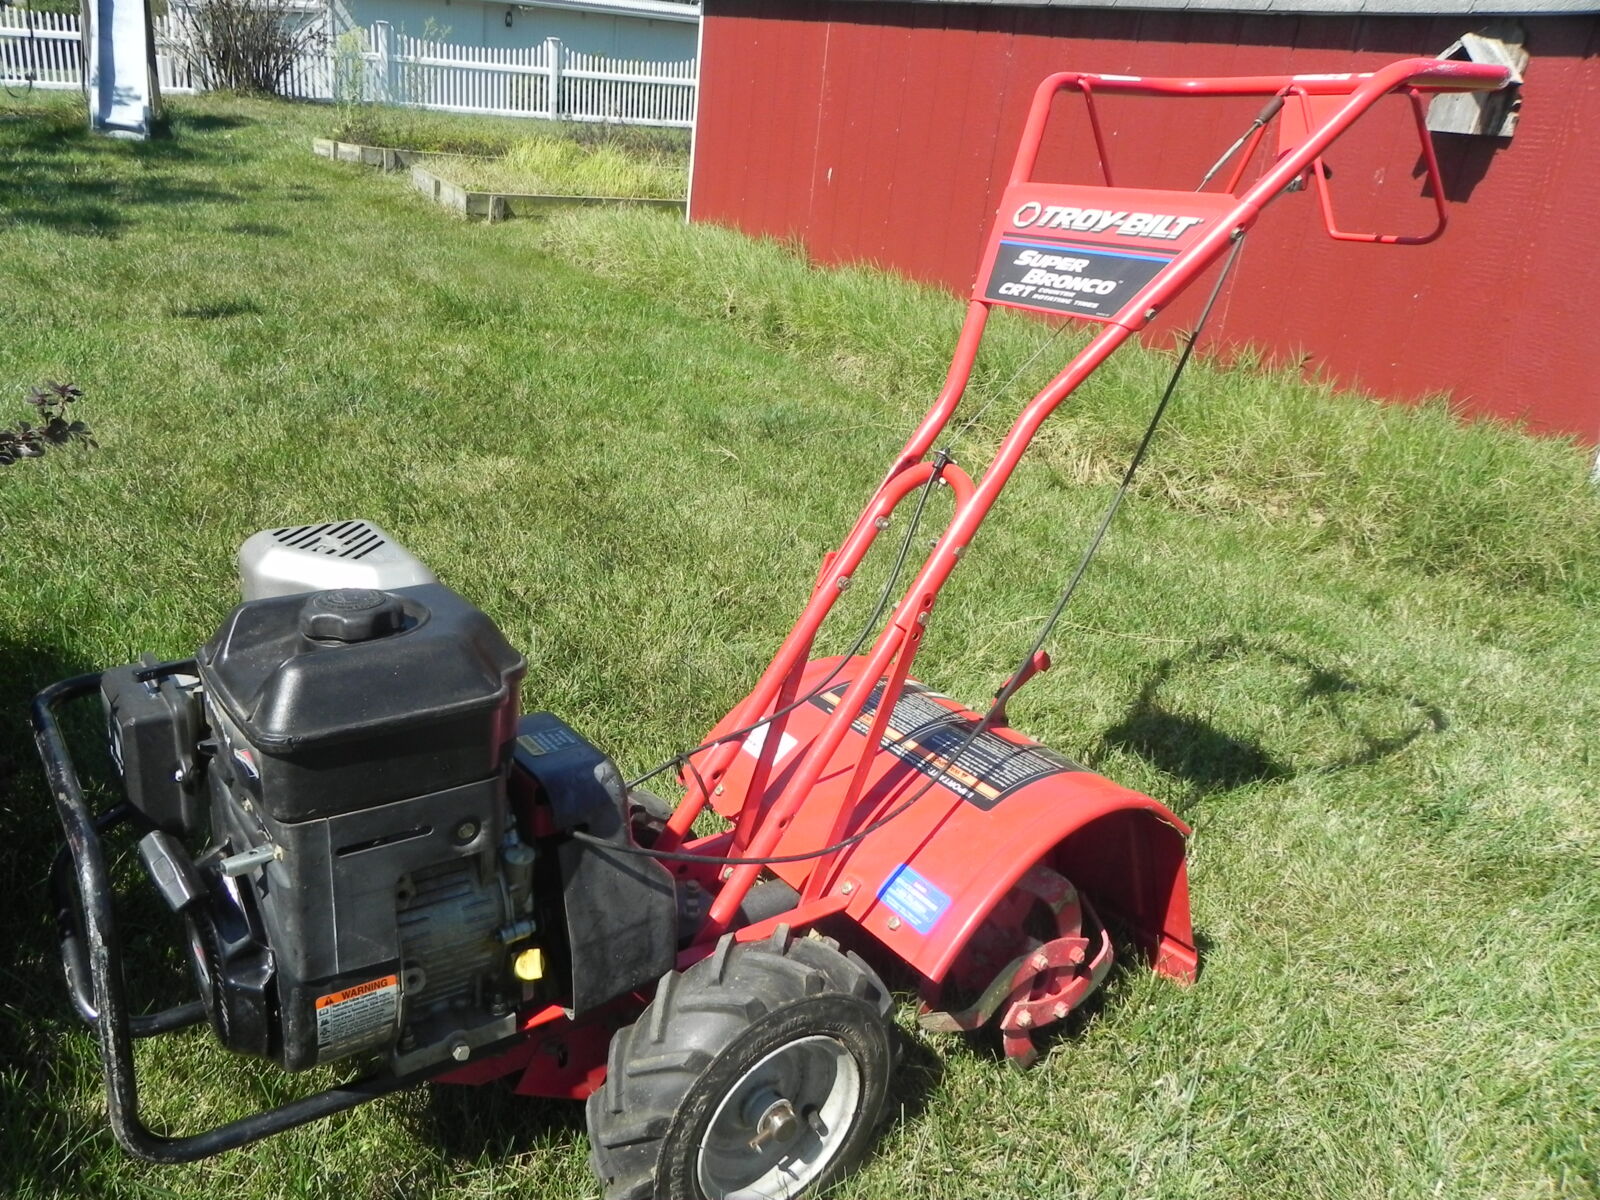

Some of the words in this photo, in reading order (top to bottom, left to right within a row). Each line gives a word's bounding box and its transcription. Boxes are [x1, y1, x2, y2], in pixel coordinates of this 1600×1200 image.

[1036, 205, 1201, 240] TROY-BILT
[1013, 249, 1090, 273] SUPER
[998, 282, 1038, 298] CRT
[1020, 268, 1118, 295] BRONCO
[1038, 287, 1077, 298] COUNTER
[1032, 293, 1074, 305] ROTATING
[341, 978, 389, 1000] WARNING
